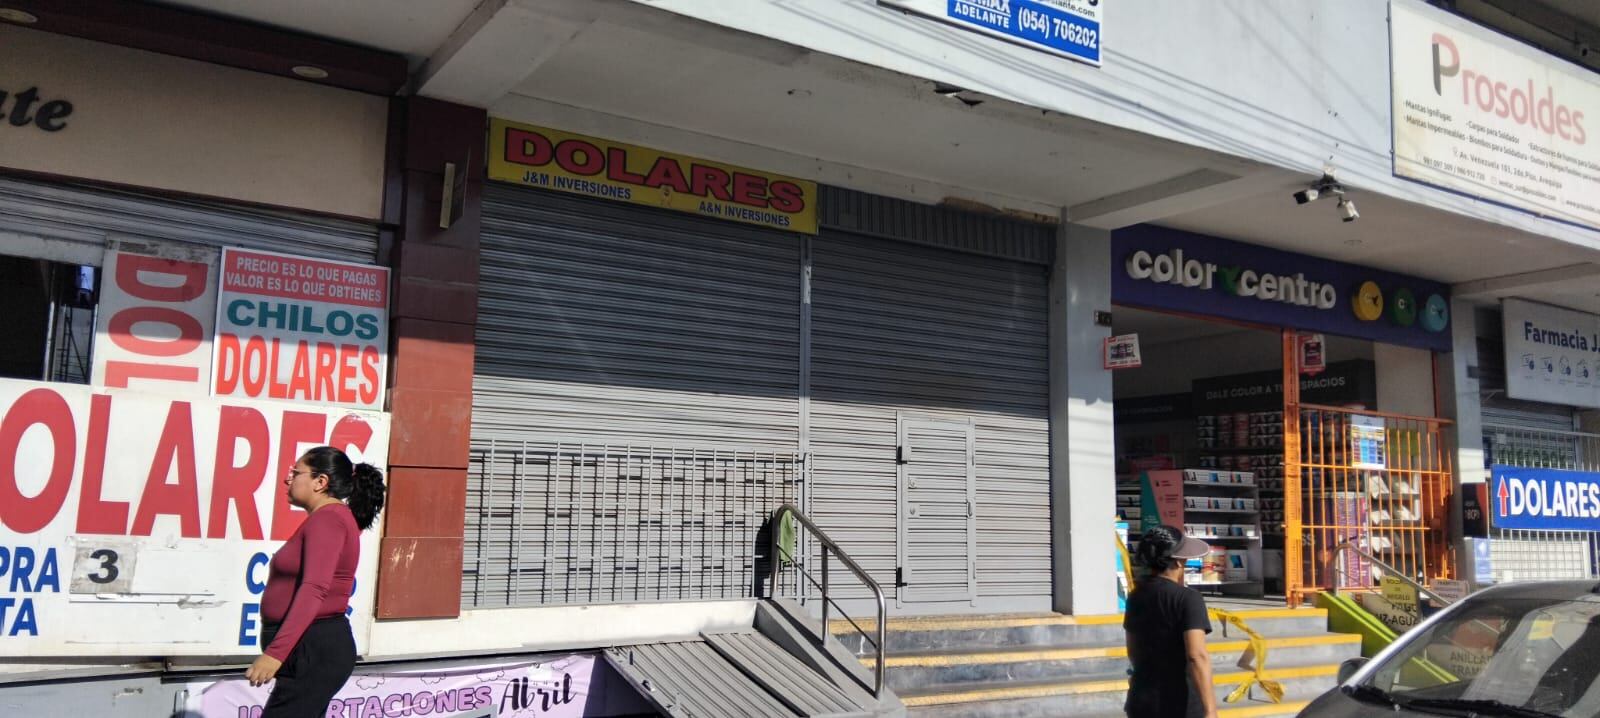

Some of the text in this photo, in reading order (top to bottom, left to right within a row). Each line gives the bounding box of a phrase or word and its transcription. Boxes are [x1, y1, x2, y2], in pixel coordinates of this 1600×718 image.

[955, 2, 1009, 28] ADELANTE
[1018, 6, 1097, 49] (054) 706202
[0, 86, 73, 132] te
[1431, 32, 1586, 145] Prosoldes
[504, 127, 805, 213] DOLARES
[523, 171, 632, 200] J&M INVERSIONES
[699, 201, 791, 226] A&N INVERSIONES
[226, 272, 382, 302] VALOR ES LO QUE OBTIENES
[236, 257, 377, 286] PRECIO ES LO QUE PAGAS
[1127, 248, 1337, 309] color centro
[227, 299, 379, 341] CHILOS
[1524, 321, 1589, 351] Farmacia
[215, 332, 380, 406] DOLARES
[1230, 386, 1263, 397] COLOR
[1300, 376, 1346, 391] SPACIOS
[1509, 477, 1600, 519] DOLARES
[87, 549, 119, 584] 3
[499, 673, 577, 715] Abril
